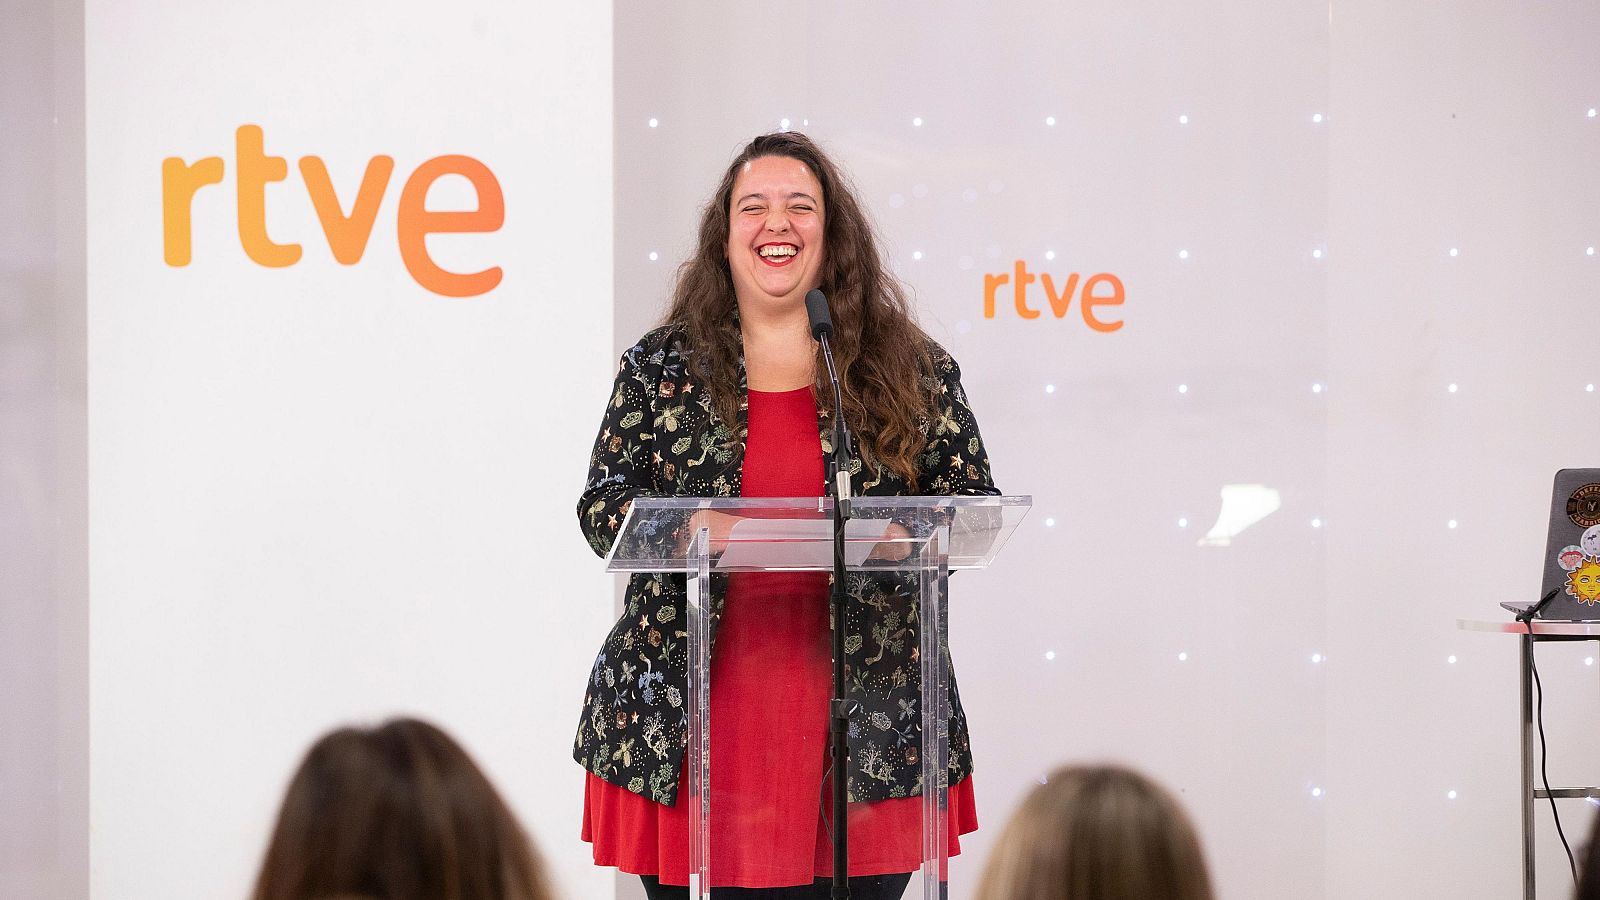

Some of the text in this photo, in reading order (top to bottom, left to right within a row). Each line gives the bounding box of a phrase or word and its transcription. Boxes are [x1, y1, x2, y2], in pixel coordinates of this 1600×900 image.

[162, 125, 505, 297] rtve
[983, 260, 1125, 332] rtve
[1579, 486, 1600, 496] DEFE
